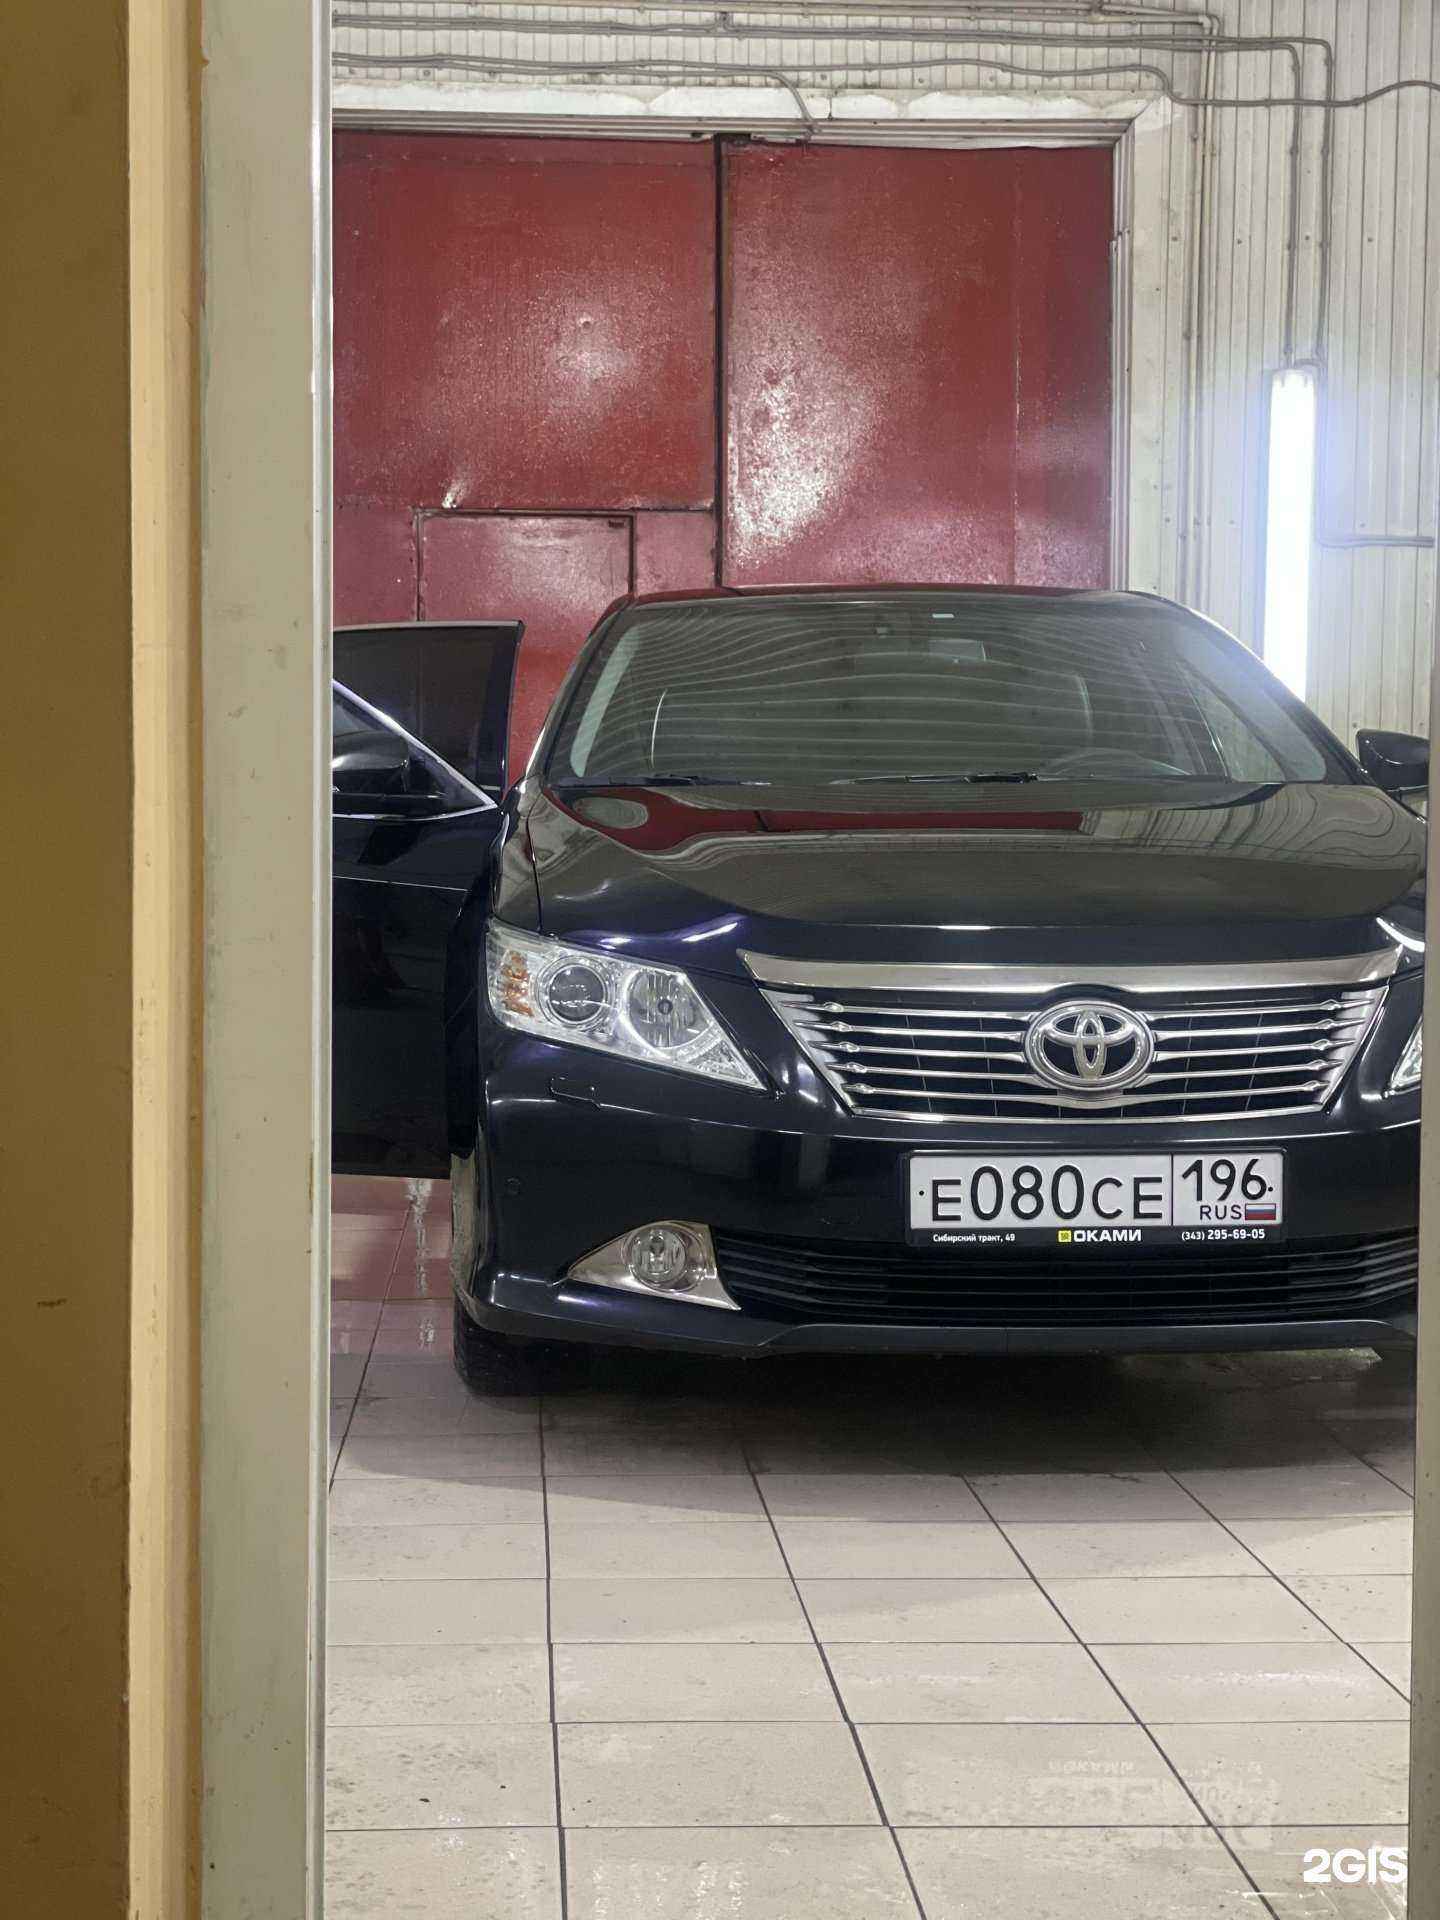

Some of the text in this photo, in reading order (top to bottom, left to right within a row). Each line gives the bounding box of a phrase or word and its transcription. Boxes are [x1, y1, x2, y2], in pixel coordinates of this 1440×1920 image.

[1181, 1158, 1267, 1202] 196
[1199, 1203, 1243, 1221] RUS
[932, 1233, 977, 1244] Сибирский
[1005, 1233, 1016, 1242] 49
[1073, 1229, 1142, 1243] ОКАМИ
[1181, 1228, 1266, 1241] (343) 295-69-05
